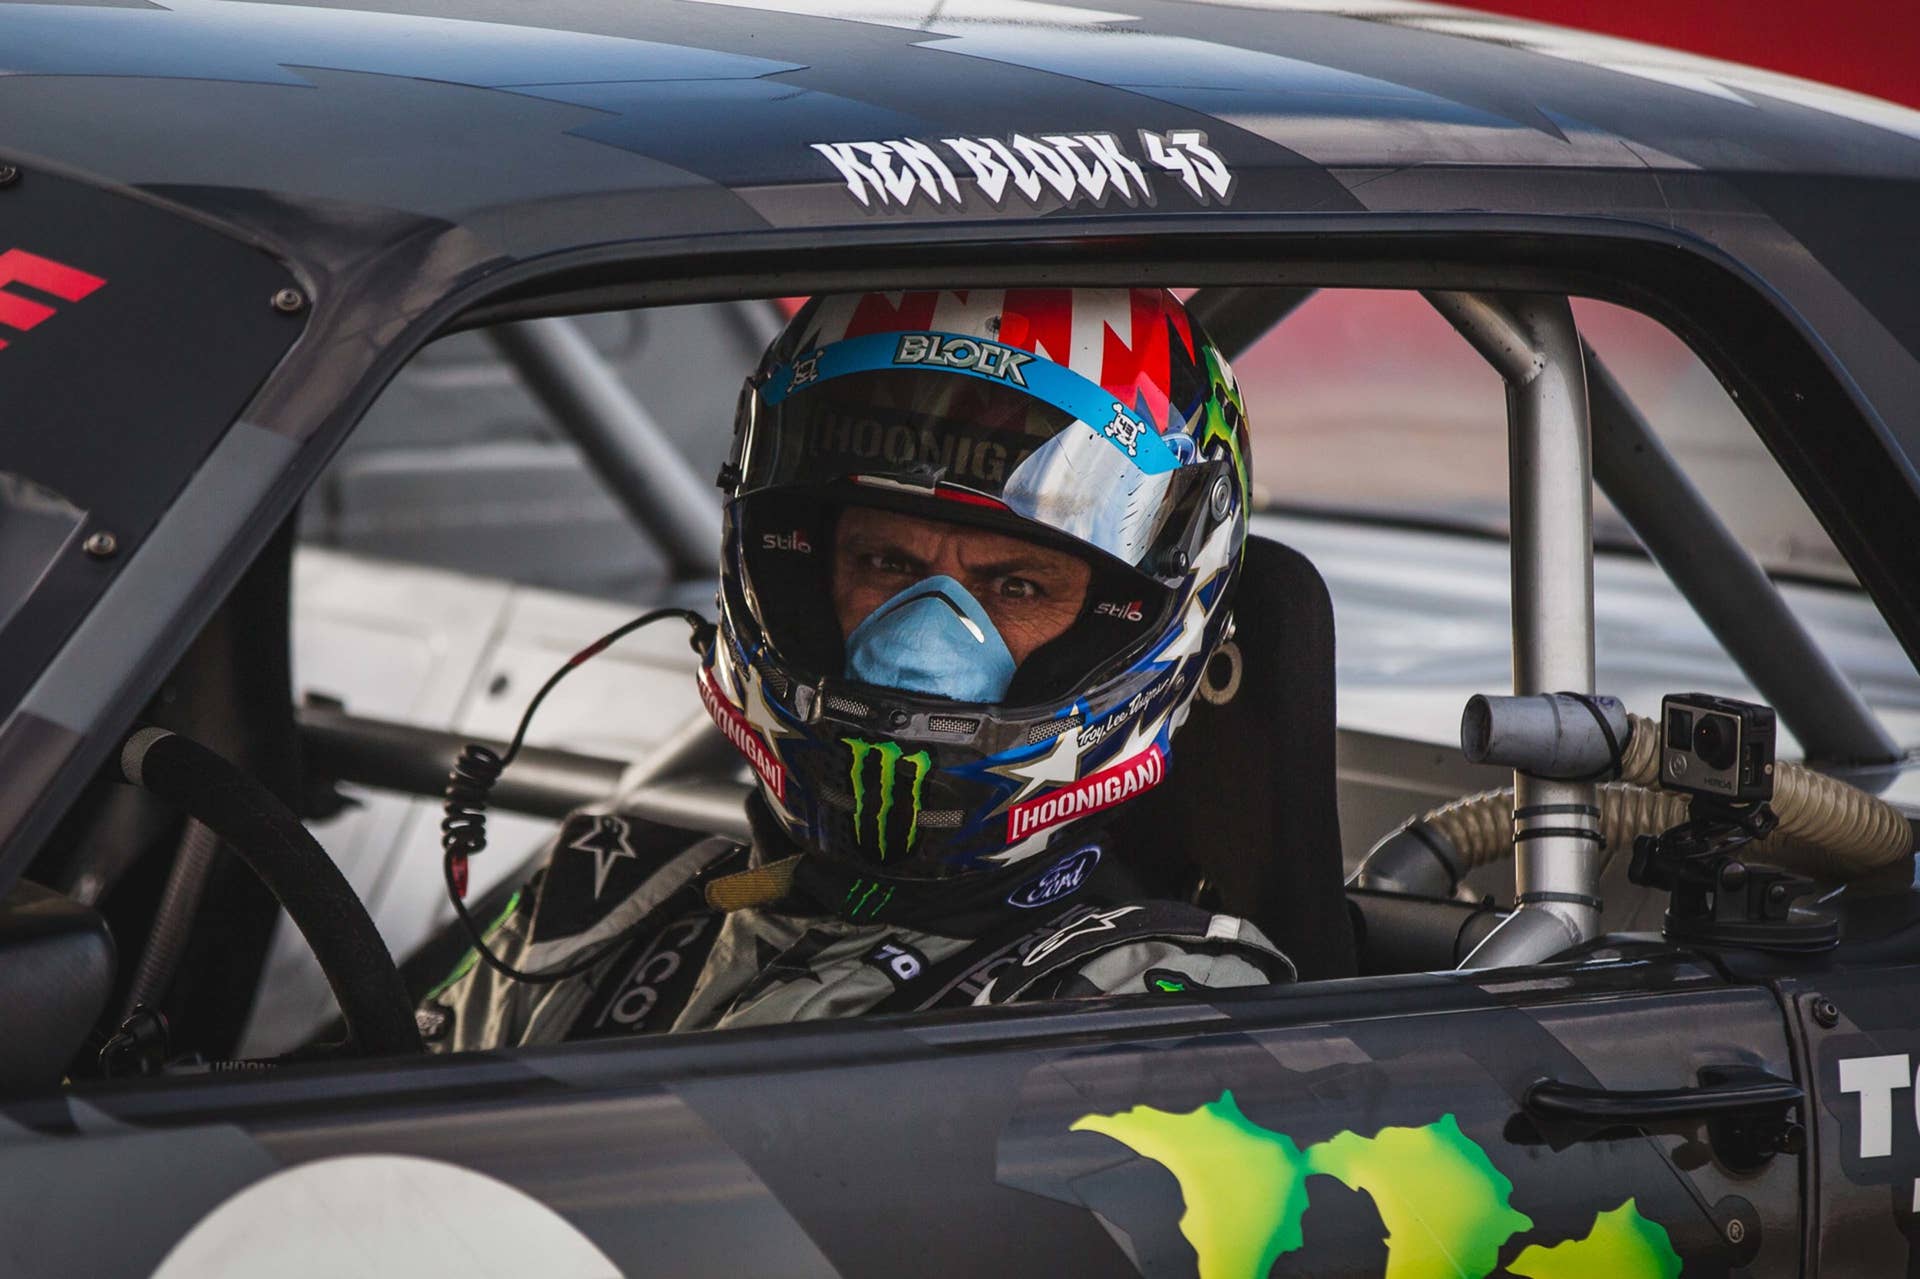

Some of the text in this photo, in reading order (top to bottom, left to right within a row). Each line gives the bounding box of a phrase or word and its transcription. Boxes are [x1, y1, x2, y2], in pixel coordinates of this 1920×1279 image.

[810, 132, 1233, 207] KEN BLOCK 43
[893, 334, 1037, 389] BLOCK
[1026, 857, 1087, 903] Ford
